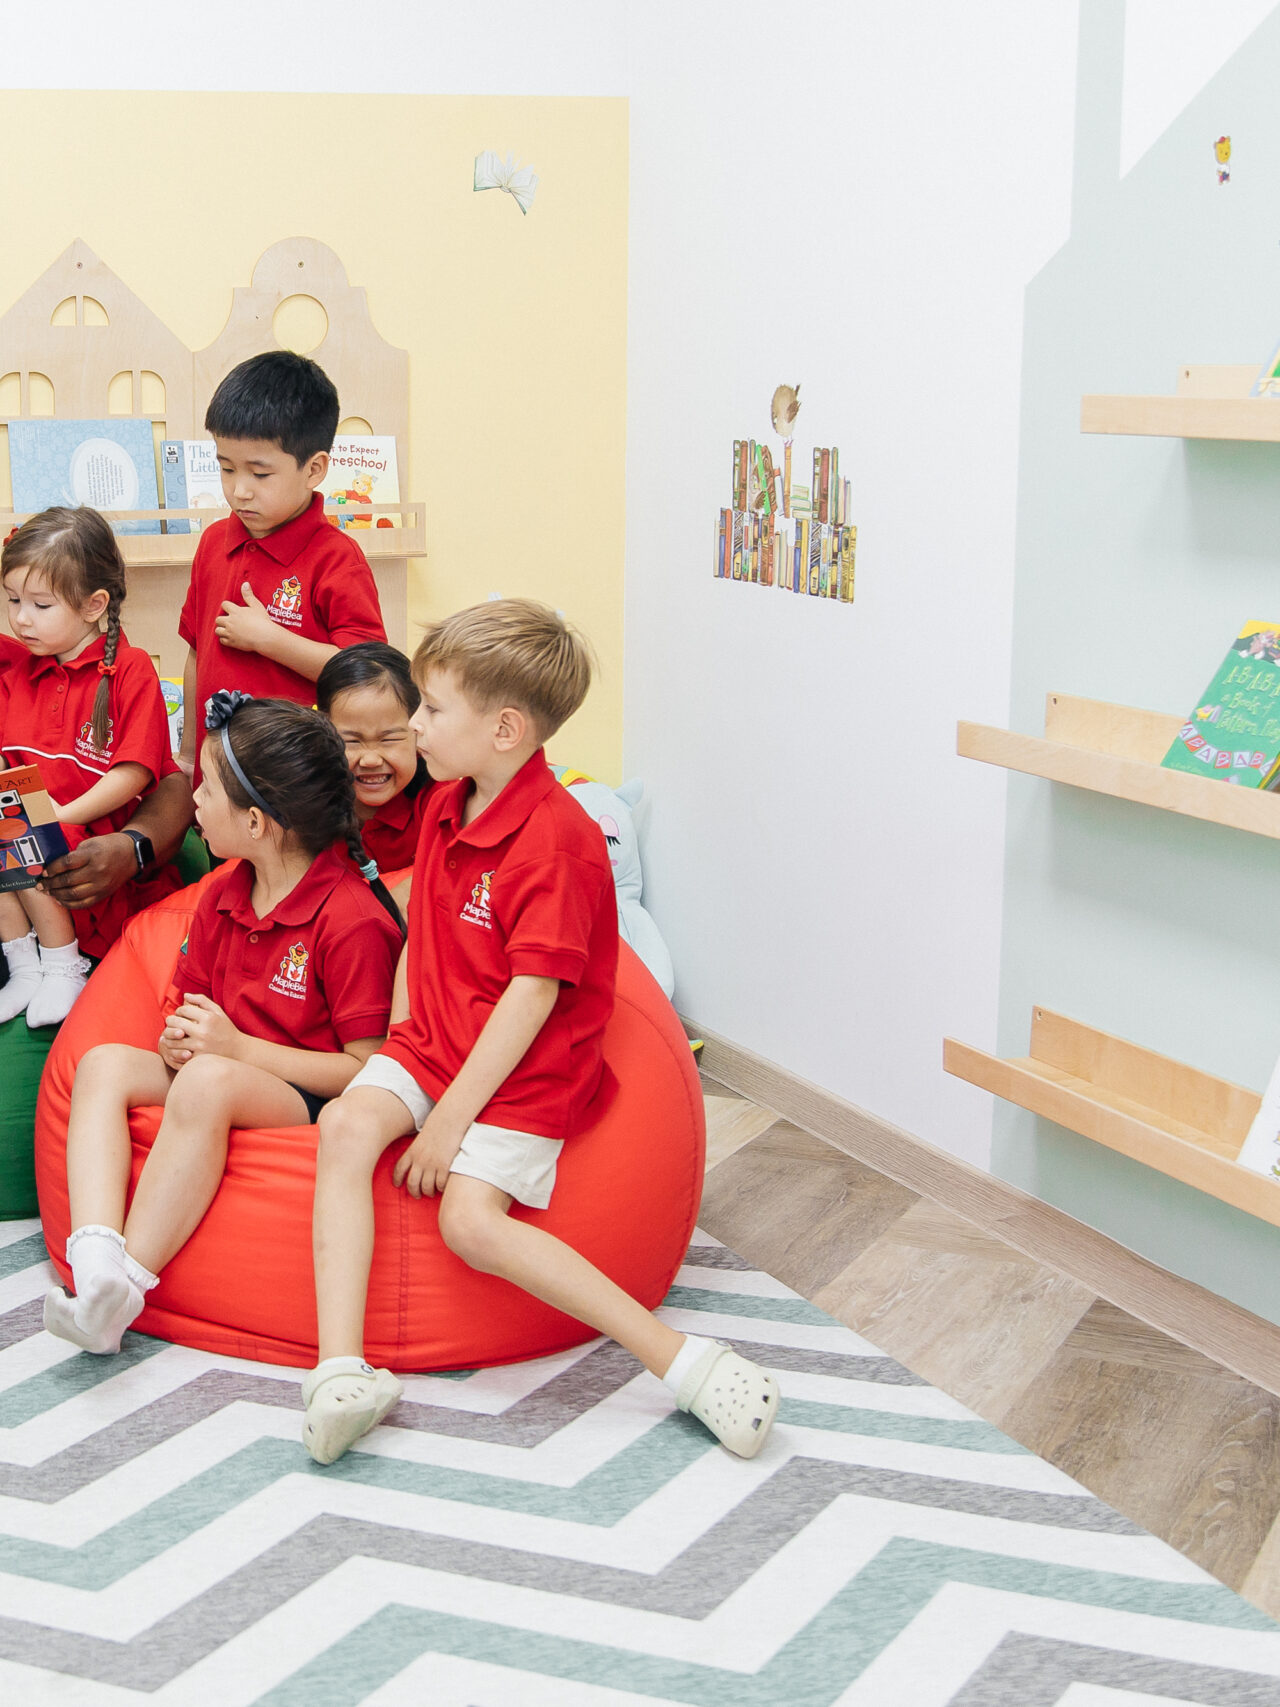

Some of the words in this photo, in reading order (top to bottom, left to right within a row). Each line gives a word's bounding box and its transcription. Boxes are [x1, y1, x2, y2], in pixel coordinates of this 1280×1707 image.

[188, 444, 212, 459] The
[338, 444, 348, 452] to
[350, 444, 380, 456] Expect
[5, 776, 34, 789] ART
